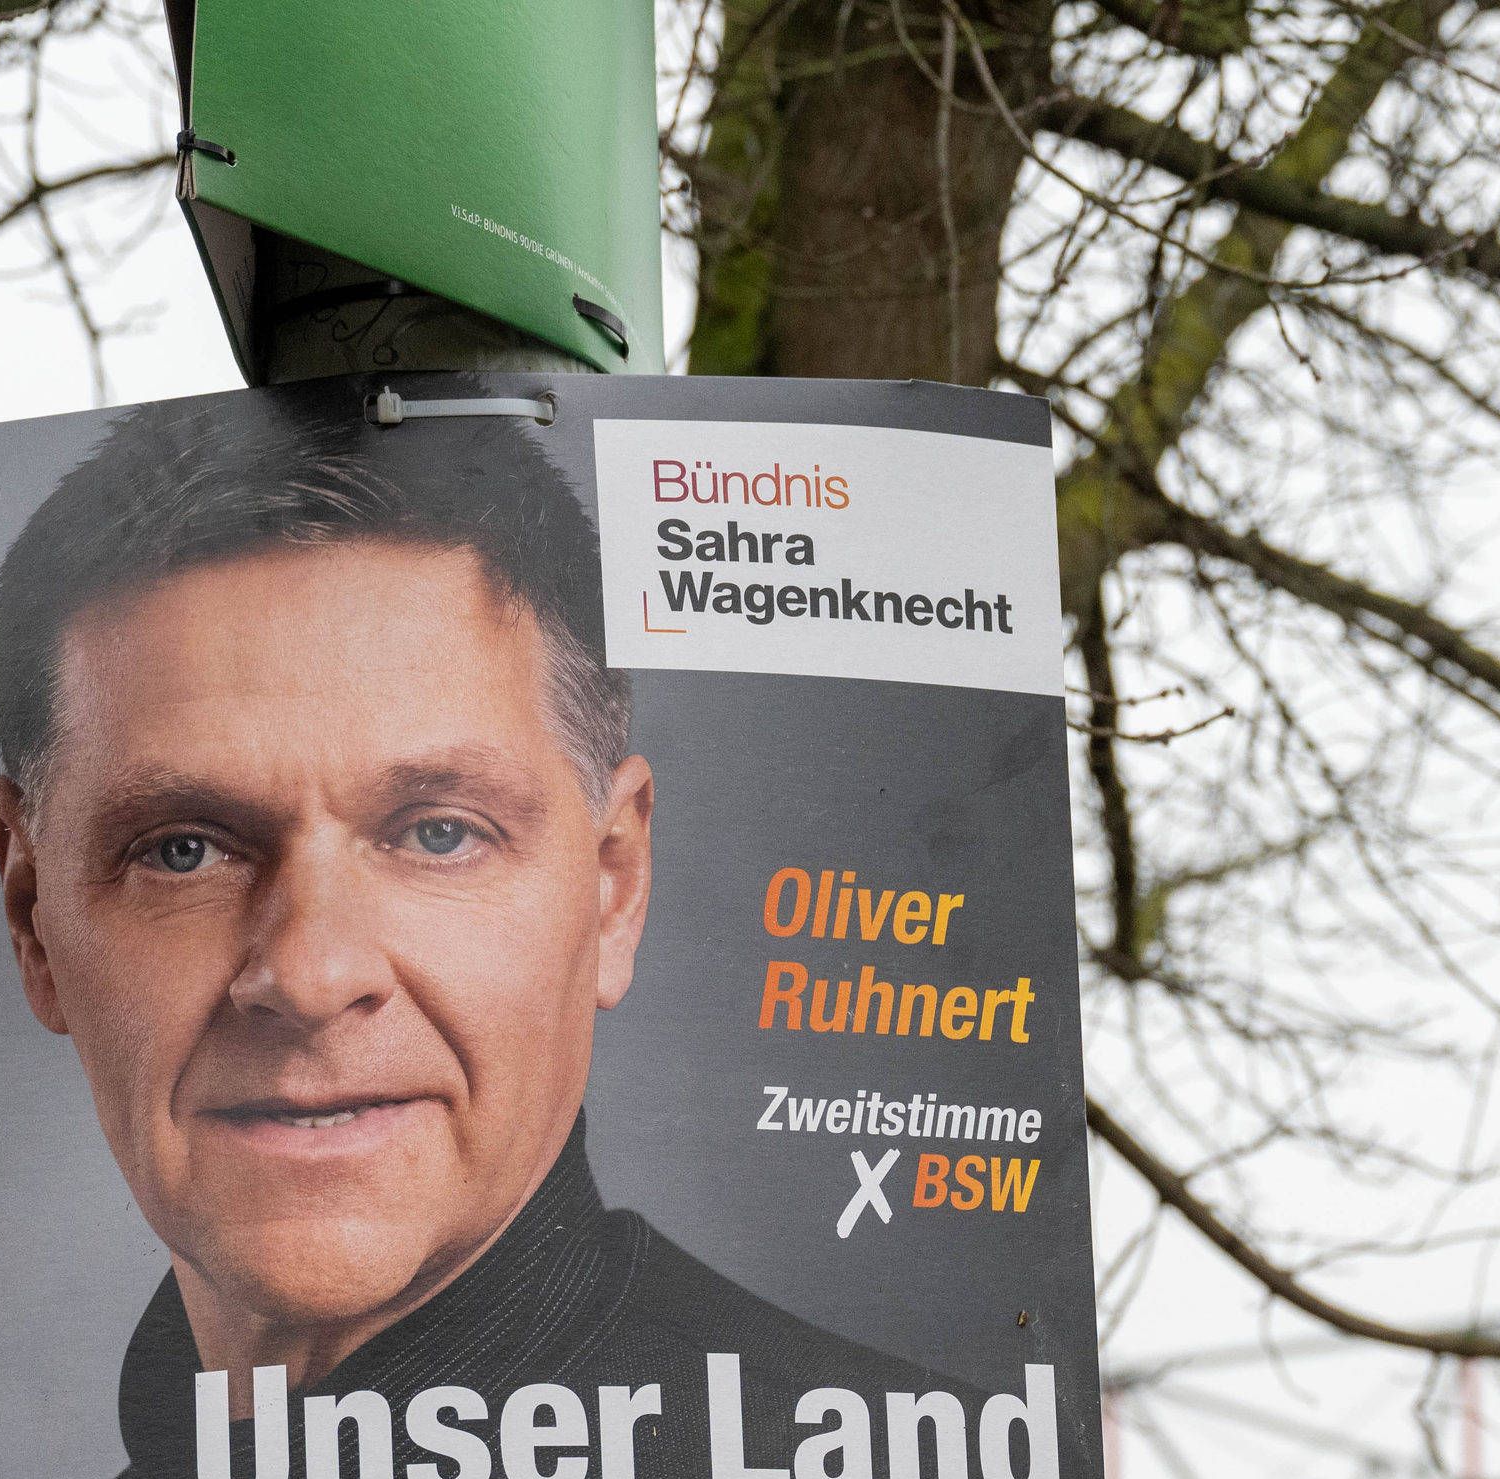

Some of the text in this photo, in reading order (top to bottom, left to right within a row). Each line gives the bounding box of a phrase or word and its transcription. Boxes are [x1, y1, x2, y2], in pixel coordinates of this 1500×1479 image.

[483, 217, 518, 244] BÜNDNIS
[519, 234, 544, 256] 90/DIE
[652, 459, 850, 510] Bündnis
[657, 517, 816, 566] Sahra
[658, 569, 1014, 634] Wagenknecht
[763, 867, 964, 945] Oliver
[757, 960, 1036, 1043] Ruhnert
[757, 1085, 1042, 1144] Zweitstimme
[912, 1153, 1041, 1213] BSW
